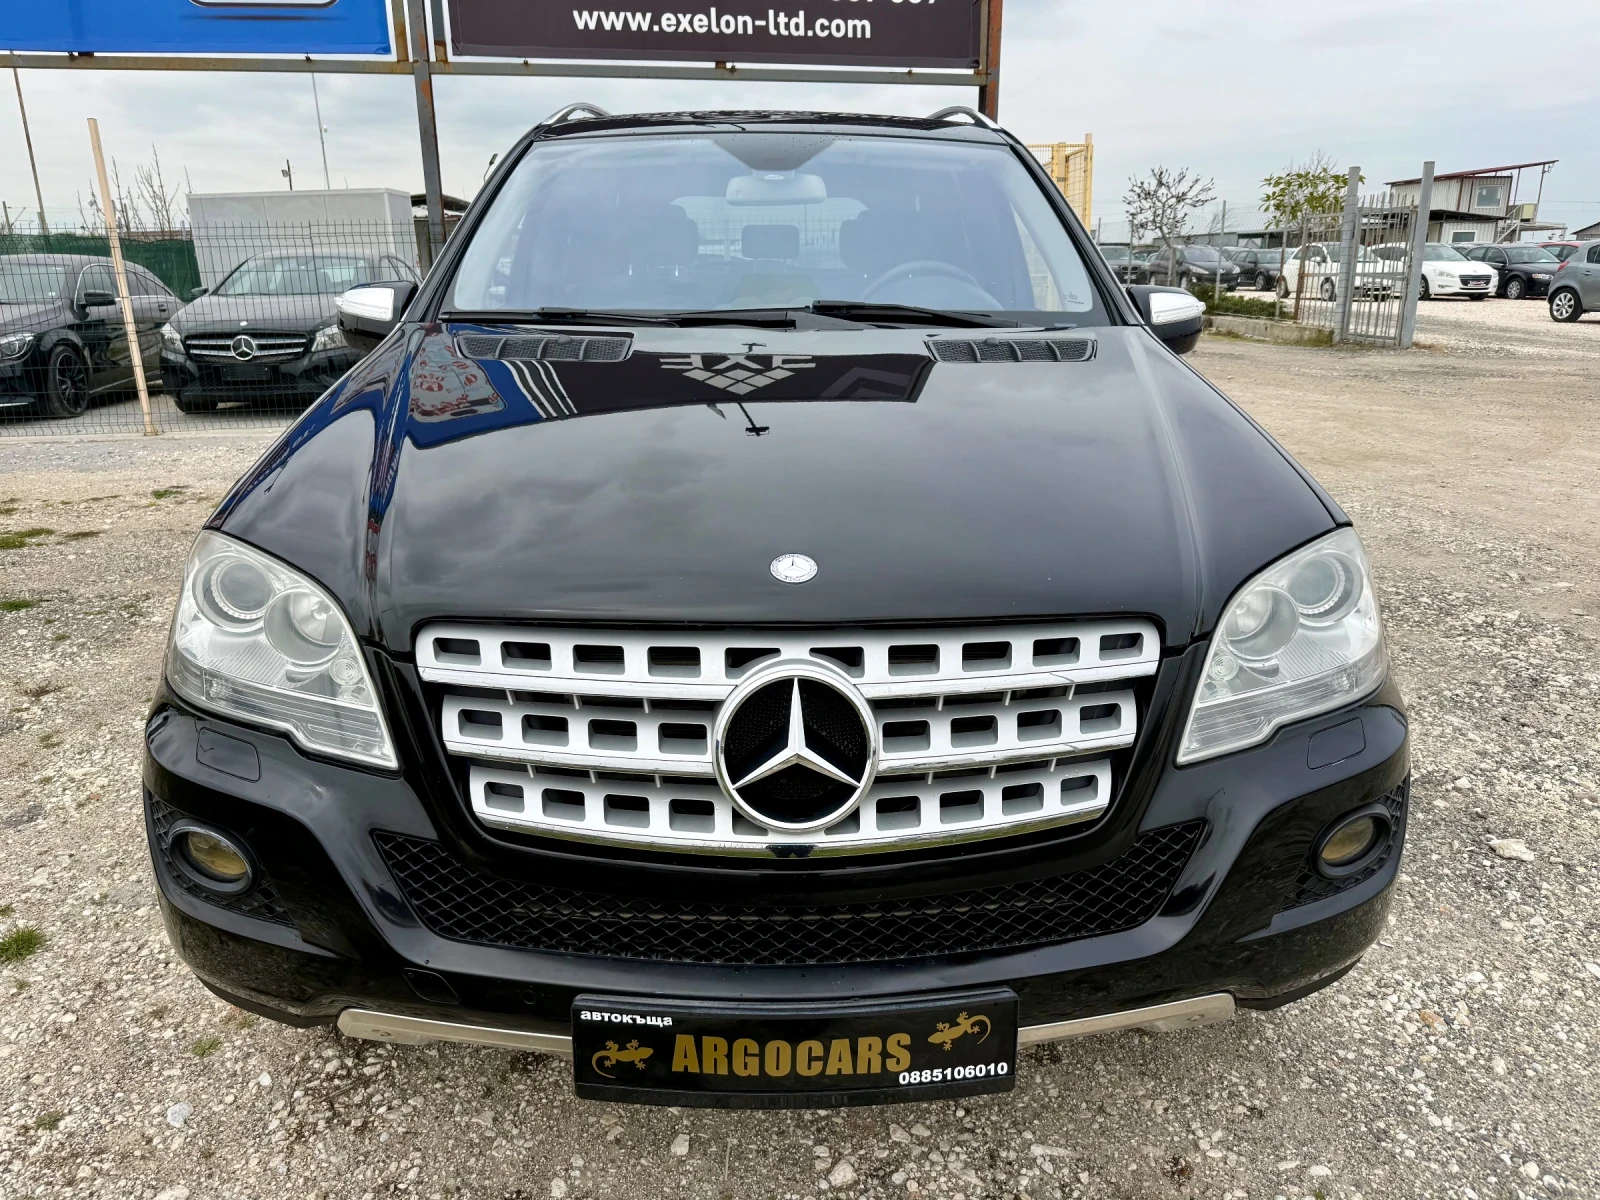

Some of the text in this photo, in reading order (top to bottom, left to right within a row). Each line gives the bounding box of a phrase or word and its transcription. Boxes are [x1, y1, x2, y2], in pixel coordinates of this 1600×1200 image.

[573, 7, 871, 39] www.exelon-ltd.com
[580, 1010, 673, 1028] автокъща
[671, 1033, 911, 1078] ARGOCARS
[898, 1061, 1008, 1085] 0885106010
